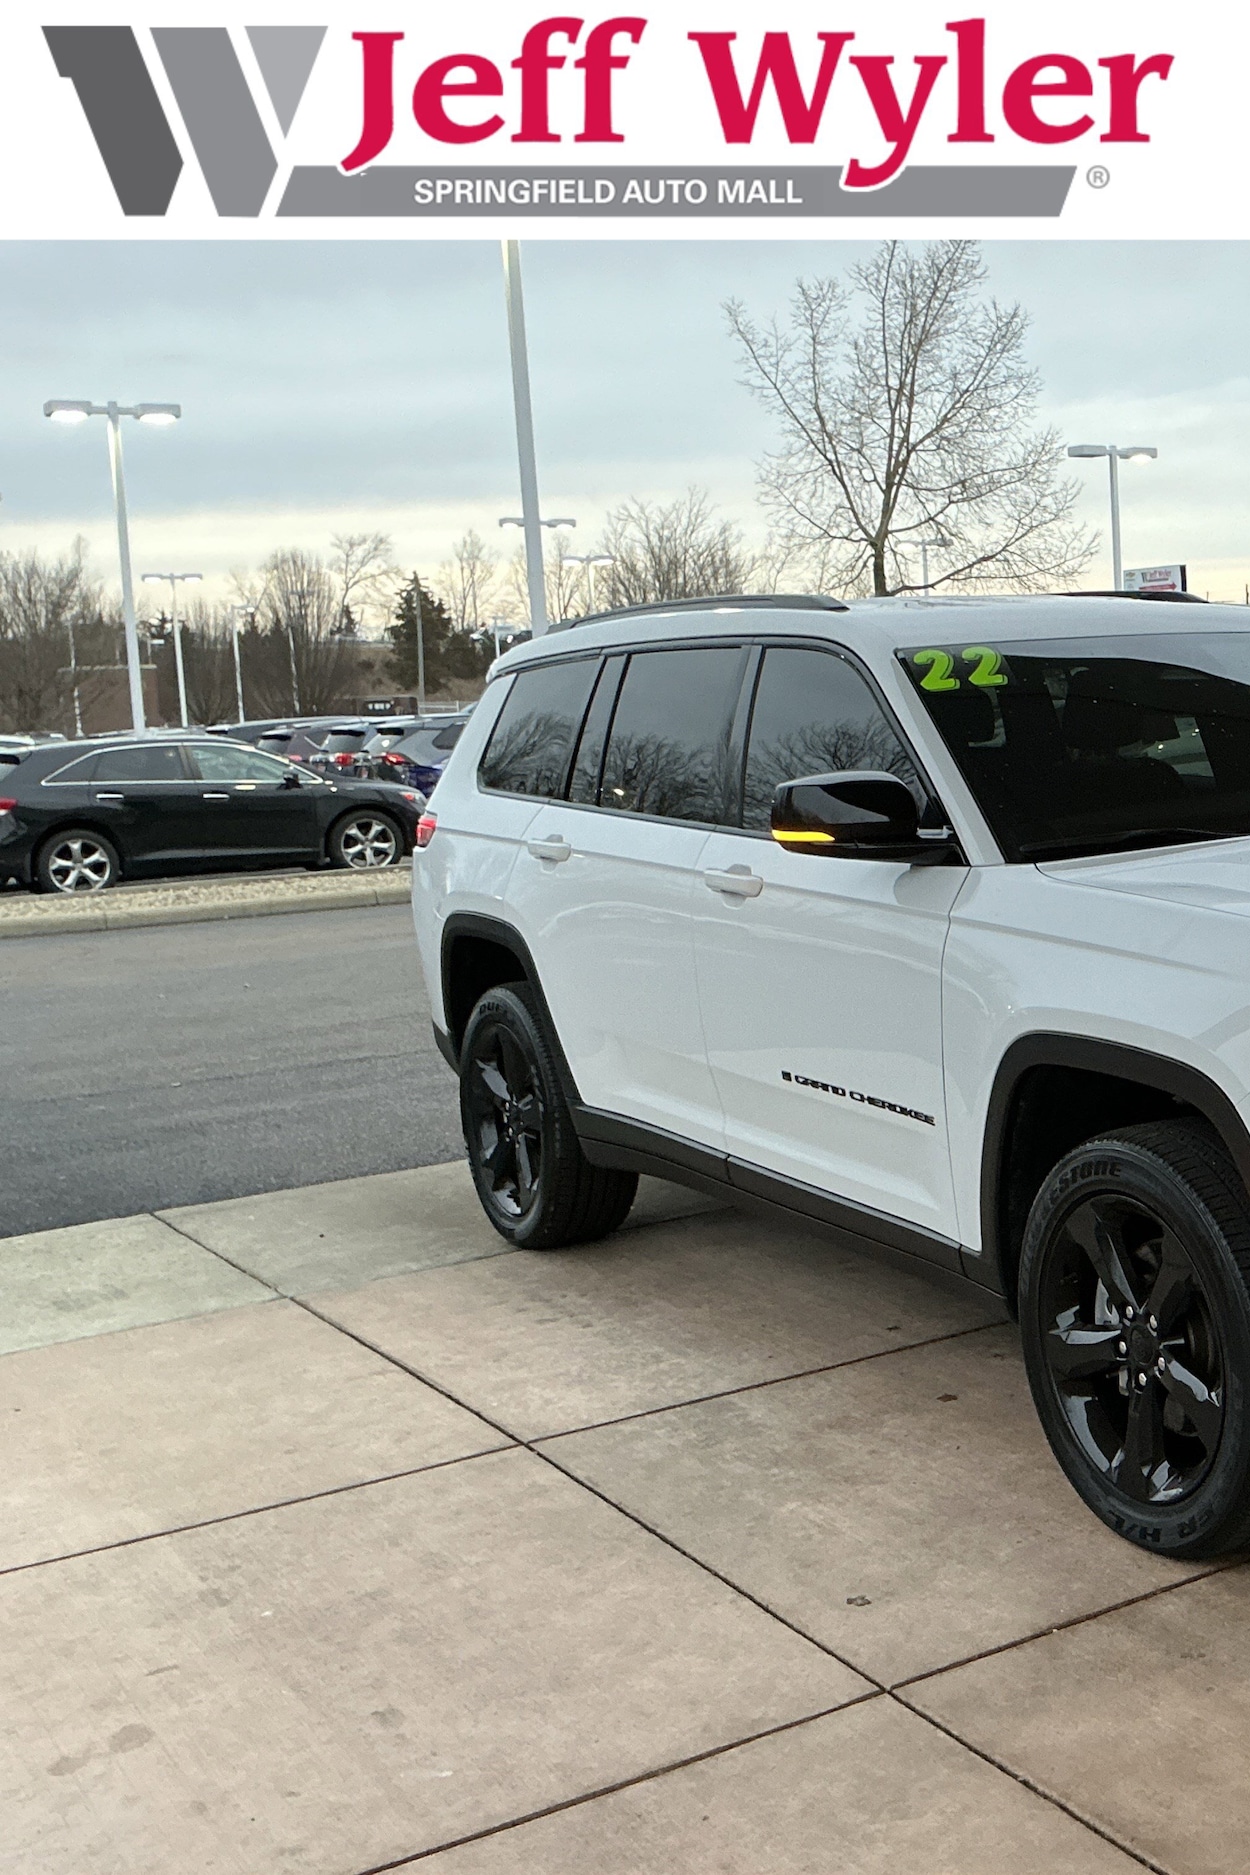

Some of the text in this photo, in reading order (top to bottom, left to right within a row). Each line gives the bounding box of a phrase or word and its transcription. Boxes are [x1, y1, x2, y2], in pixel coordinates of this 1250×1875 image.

[913, 646, 1008, 692] 22
[794, 1074, 936, 1127] GRAND CHEROKEE
